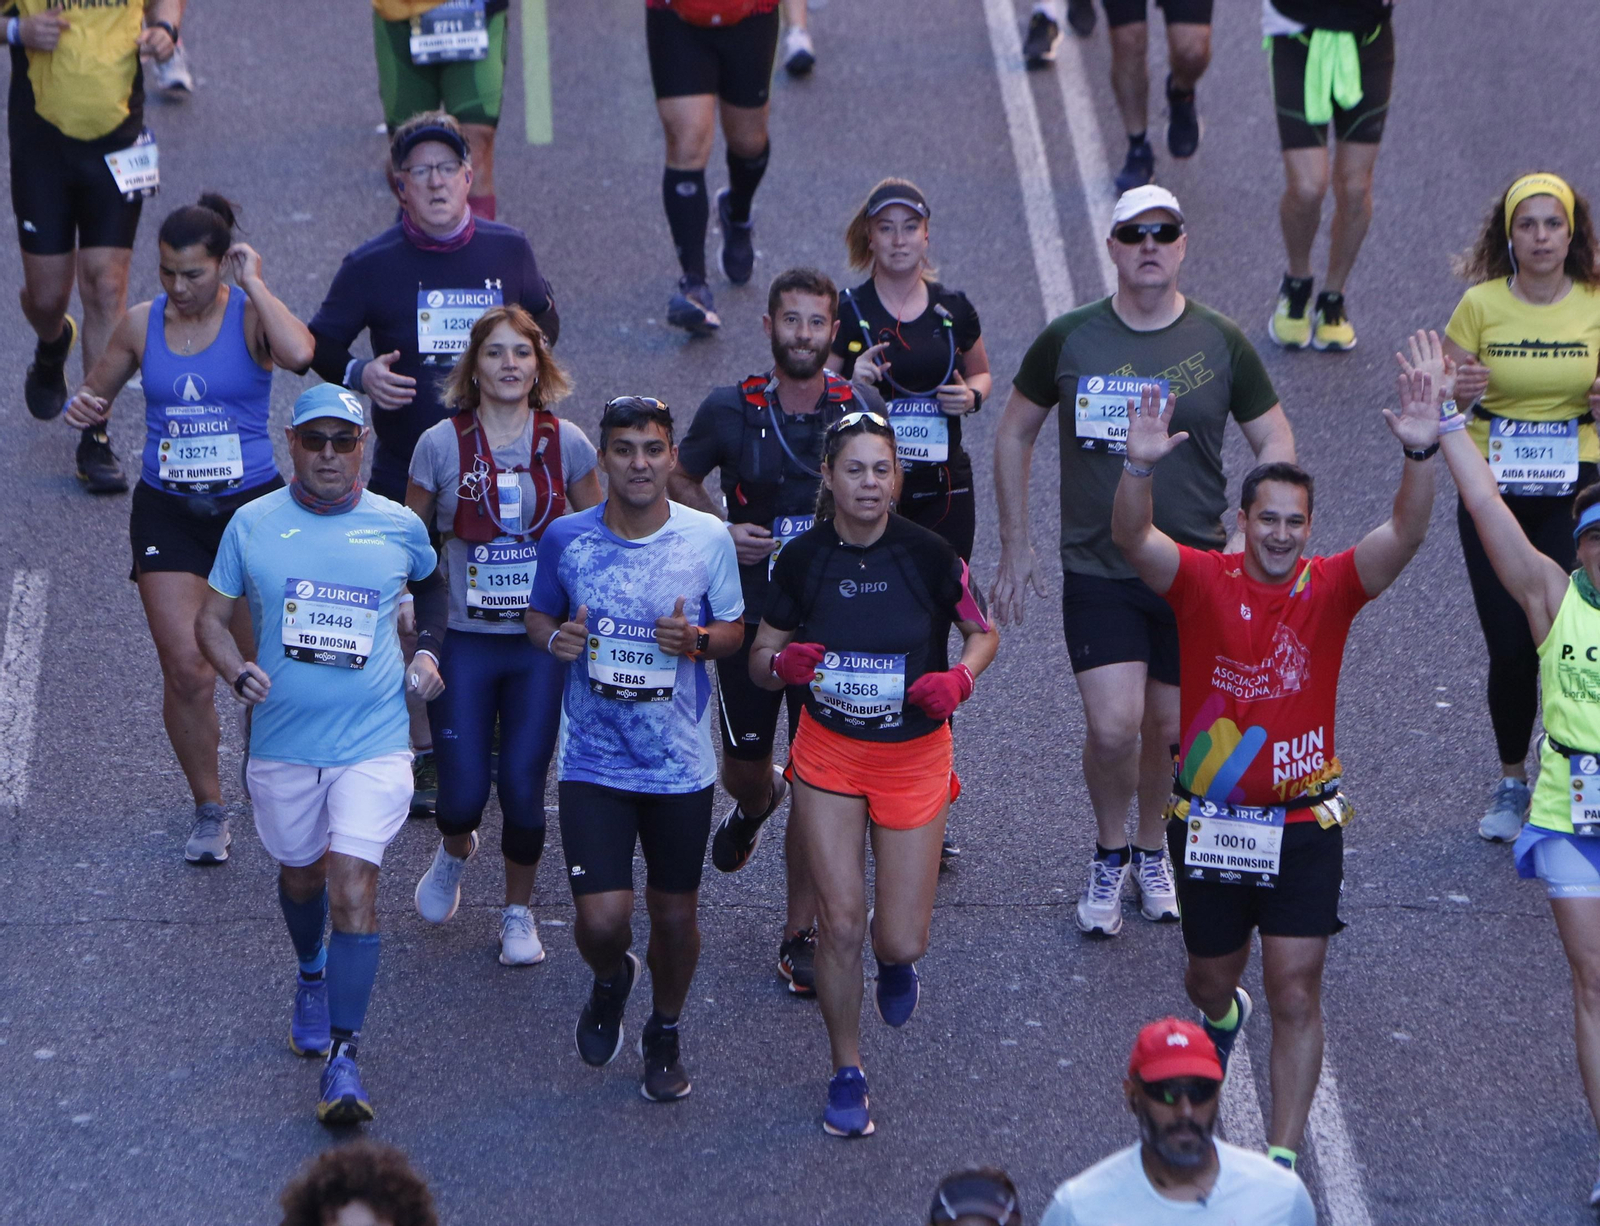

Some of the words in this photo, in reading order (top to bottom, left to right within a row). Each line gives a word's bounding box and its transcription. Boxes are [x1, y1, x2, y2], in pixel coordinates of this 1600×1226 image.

[447, 294, 493, 305] ZURICH
[443, 318, 478, 330] 1236
[432, 340, 470, 349] 725278
[166, 407, 204, 415] FITNESS
[895, 402, 939, 414] ZURICH
[182, 421, 228, 434] ZURICH
[1108, 427, 1128, 437] GAR
[1518, 423, 1568, 434] ZURICH
[179, 446, 218, 459] 13274
[1514, 447, 1554, 459] 13871
[168, 468, 185, 478] HUT
[187, 467, 232, 478] RUNNERS
[1501, 469, 1524, 478] AIDA
[1527, 469, 1566, 479] FRANCO
[795, 520, 814, 532] ZU
[492, 546, 538, 561] ZURICH
[487, 572, 530, 586] 13184
[317, 587, 368, 604] ZURICH
[309, 612, 353, 628] 12448
[299, 634, 317, 645] TEO
[319, 636, 357, 650] MOSNA
[610, 649, 654, 665] 13676
[1561, 644, 1575, 660] P.
[843, 656, 893, 669] ZURICH
[613, 672, 646, 685] SEBAS
[835, 681, 879, 696] 13568
[823, 696, 891, 715] SUPERABUELA
[1273, 726, 1324, 766] RUN
[1273, 751, 1325, 785] NING
[1214, 834, 1256, 850] 10010
[1190, 851, 1224, 865] BJORN
[1227, 855, 1275, 870] IRONSIDE
